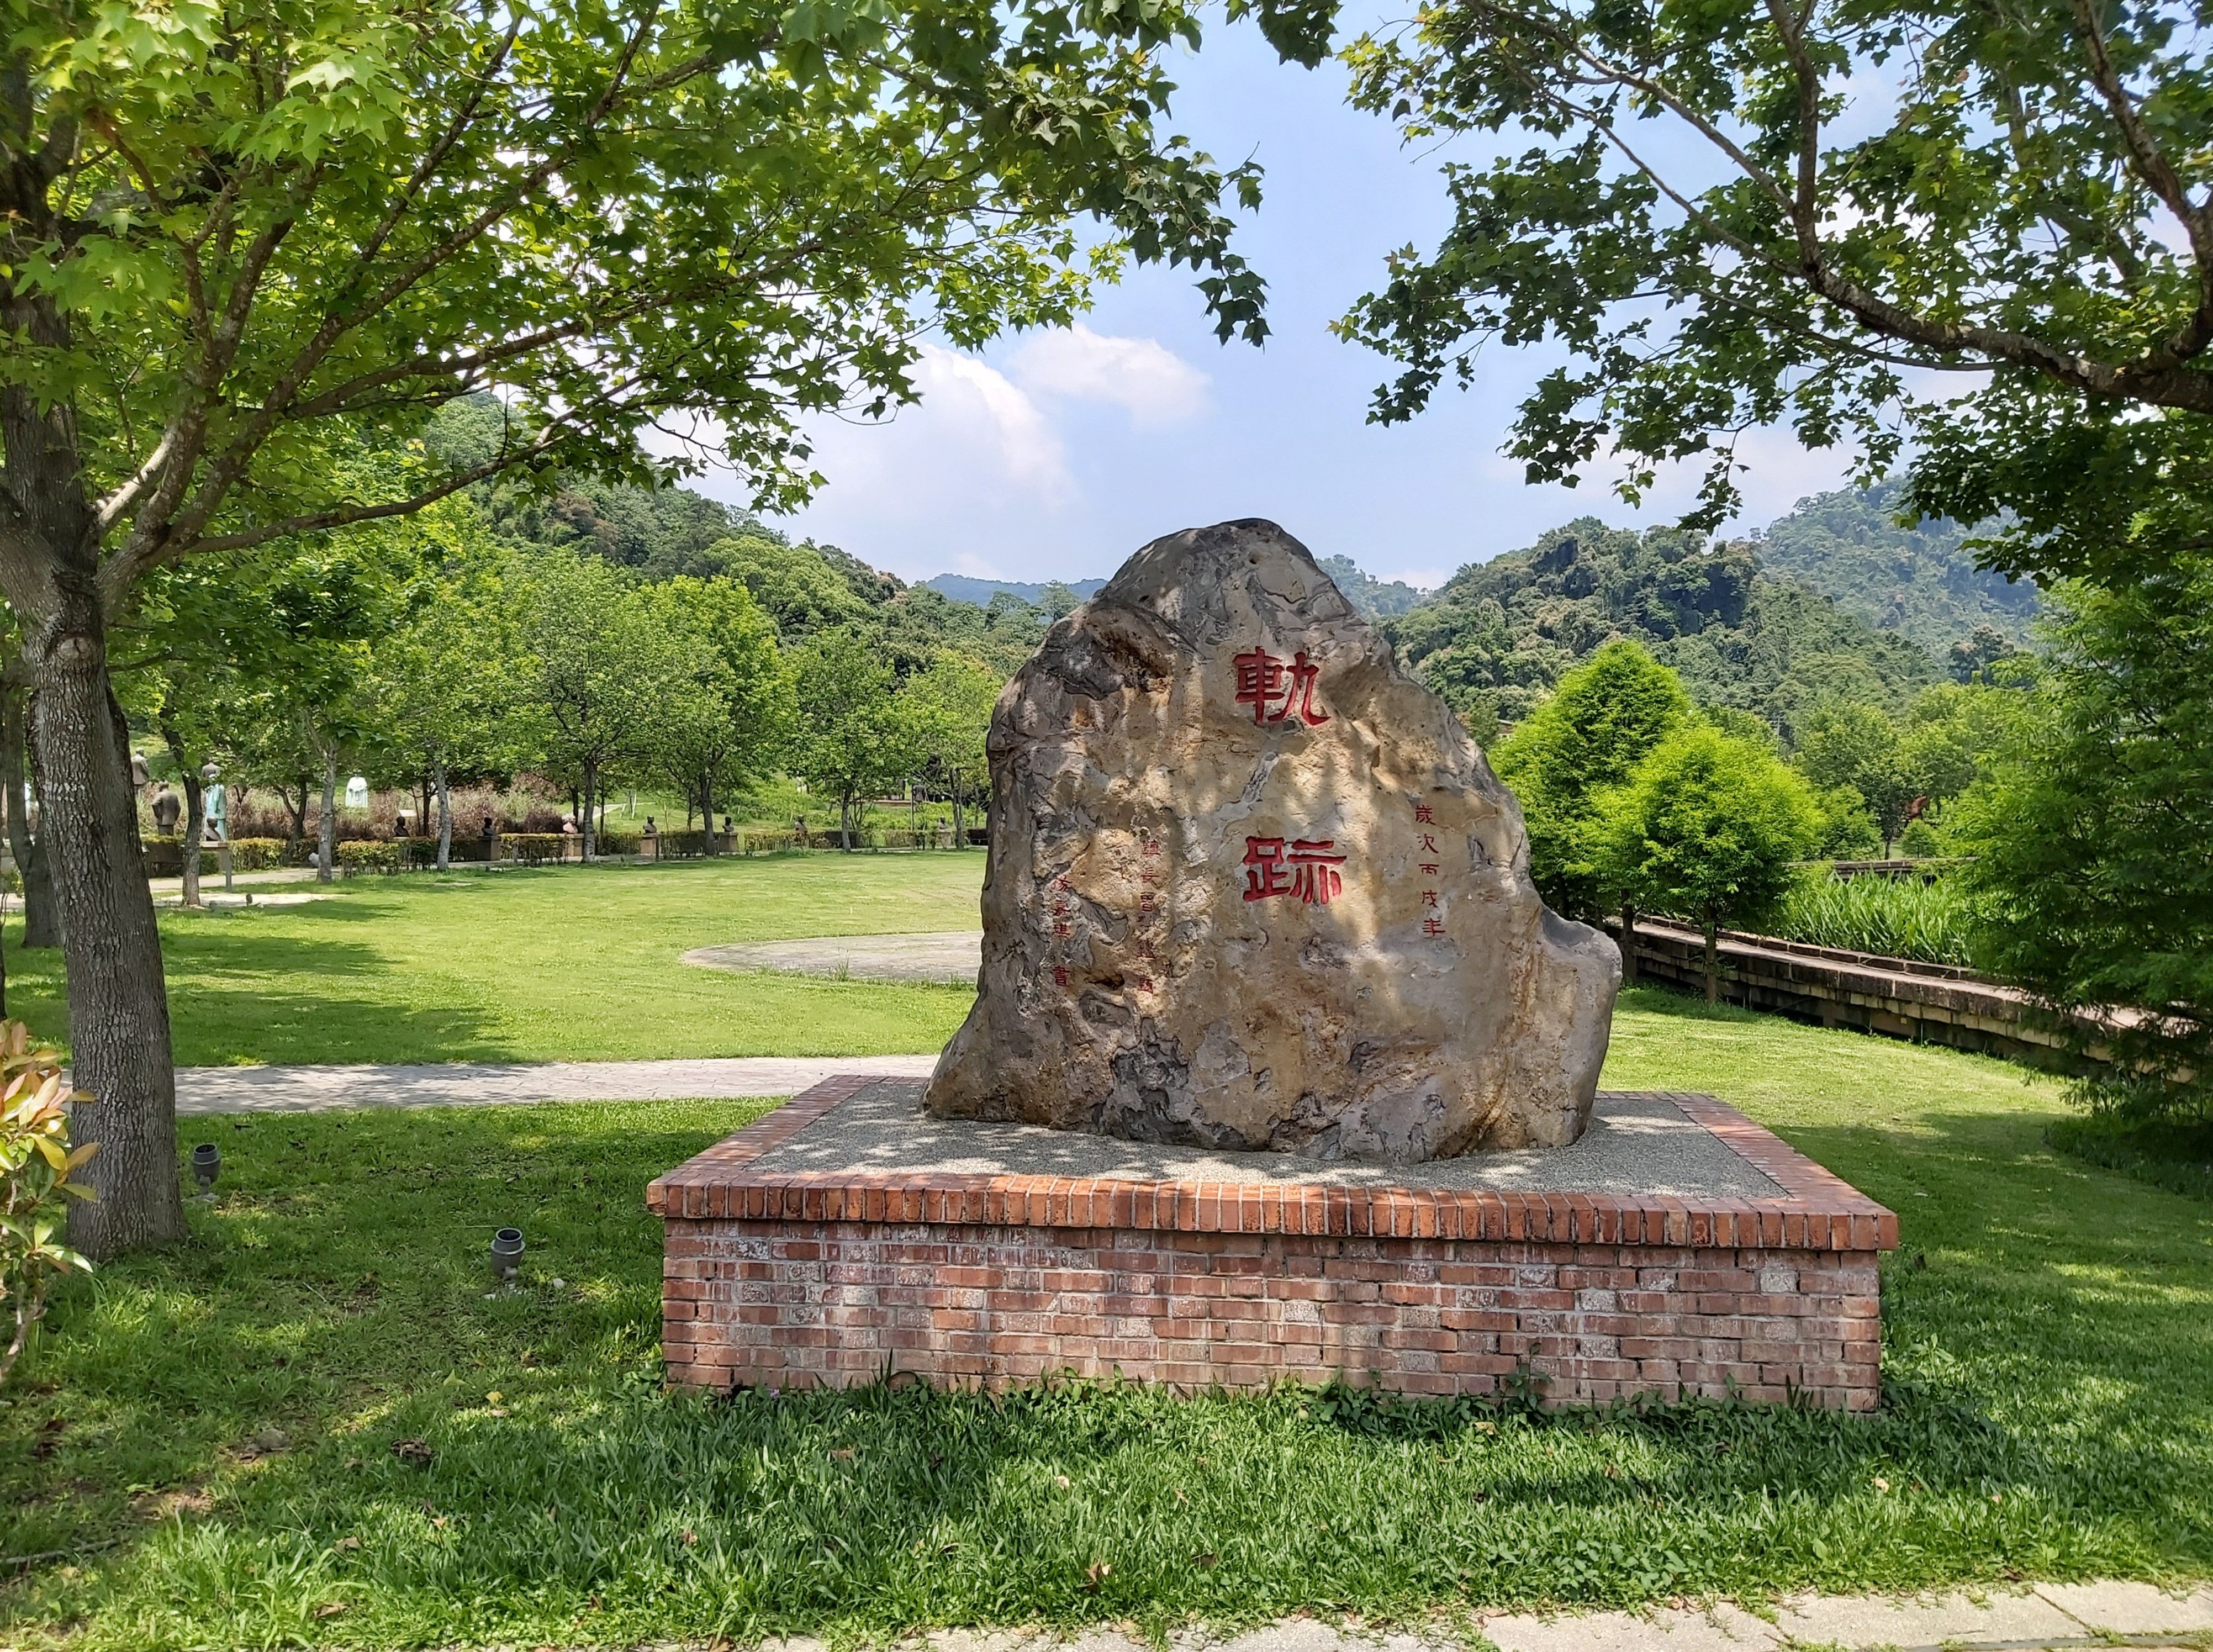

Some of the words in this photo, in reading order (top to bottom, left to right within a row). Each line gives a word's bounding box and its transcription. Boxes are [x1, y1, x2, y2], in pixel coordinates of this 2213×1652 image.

[1232, 646, 1347, 905] 軌跡
[1415, 804, 1446, 937] 歲次丙戌年
